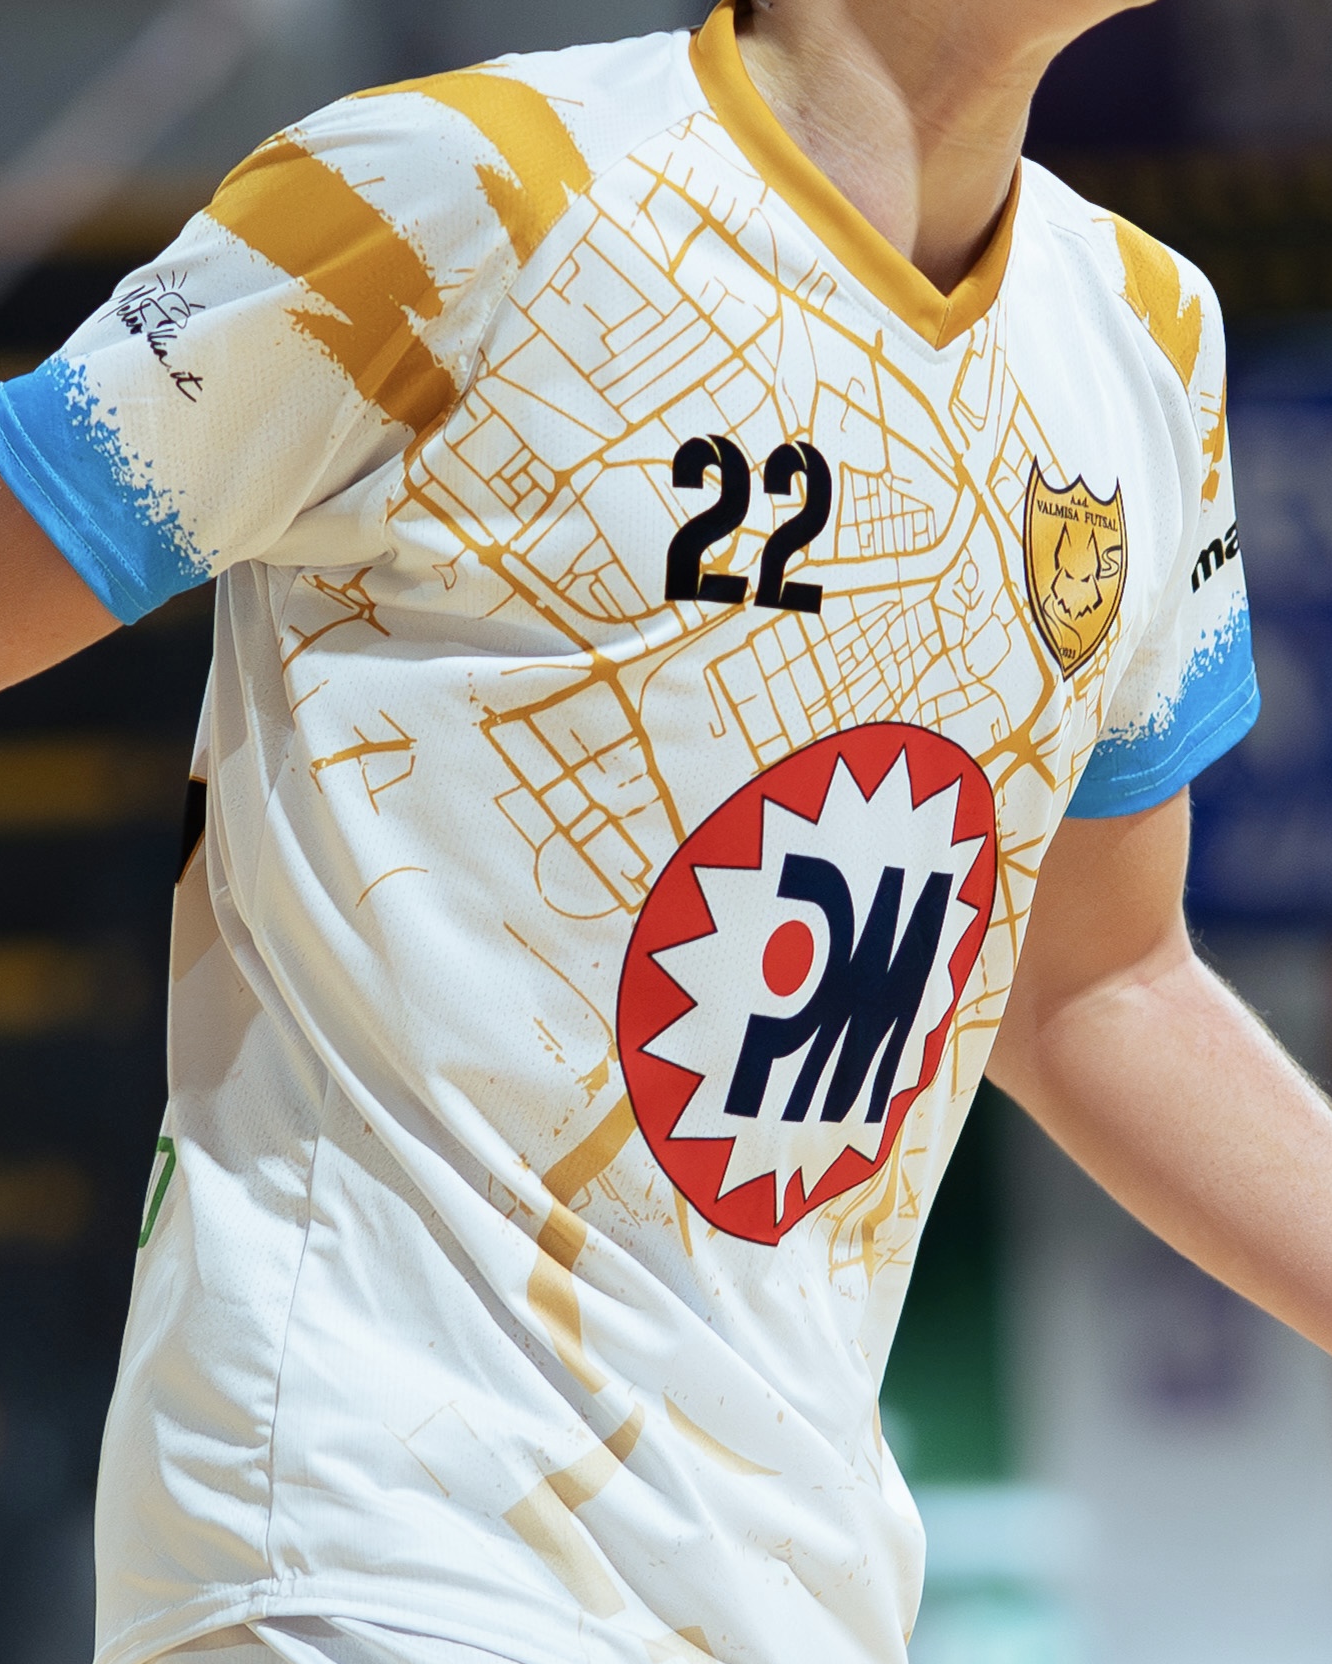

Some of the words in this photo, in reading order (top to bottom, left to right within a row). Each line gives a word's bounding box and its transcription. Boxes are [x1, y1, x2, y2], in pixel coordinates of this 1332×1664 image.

[664, 433, 833, 615] 22
[1036, 498, 1080, 522] VALMISA
[1084, 510, 1118, 533] FUTSAL
